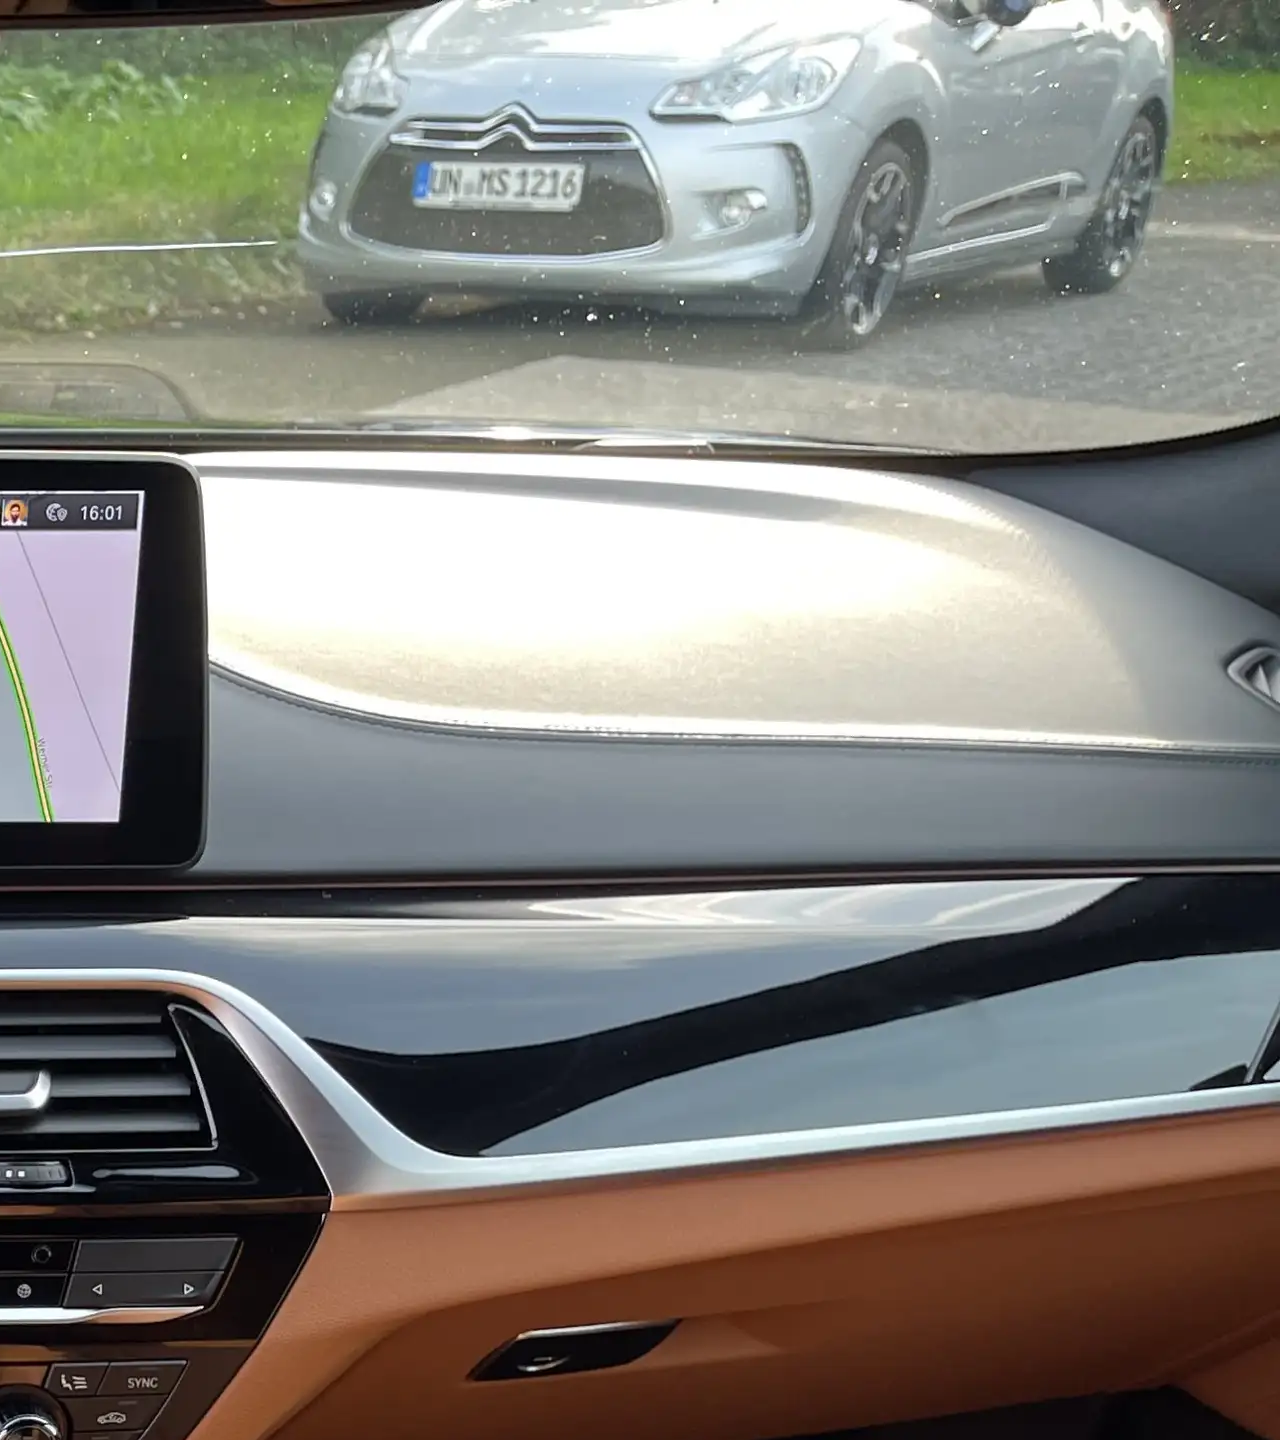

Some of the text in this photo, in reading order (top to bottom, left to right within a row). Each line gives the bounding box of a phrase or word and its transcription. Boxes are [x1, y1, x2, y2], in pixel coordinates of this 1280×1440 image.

[481, 168, 510, 196] MS
[514, 169, 577, 199] 1216
[80, 506, 123, 521] 16:01
[128, 1378, 158, 1390] SYNC
